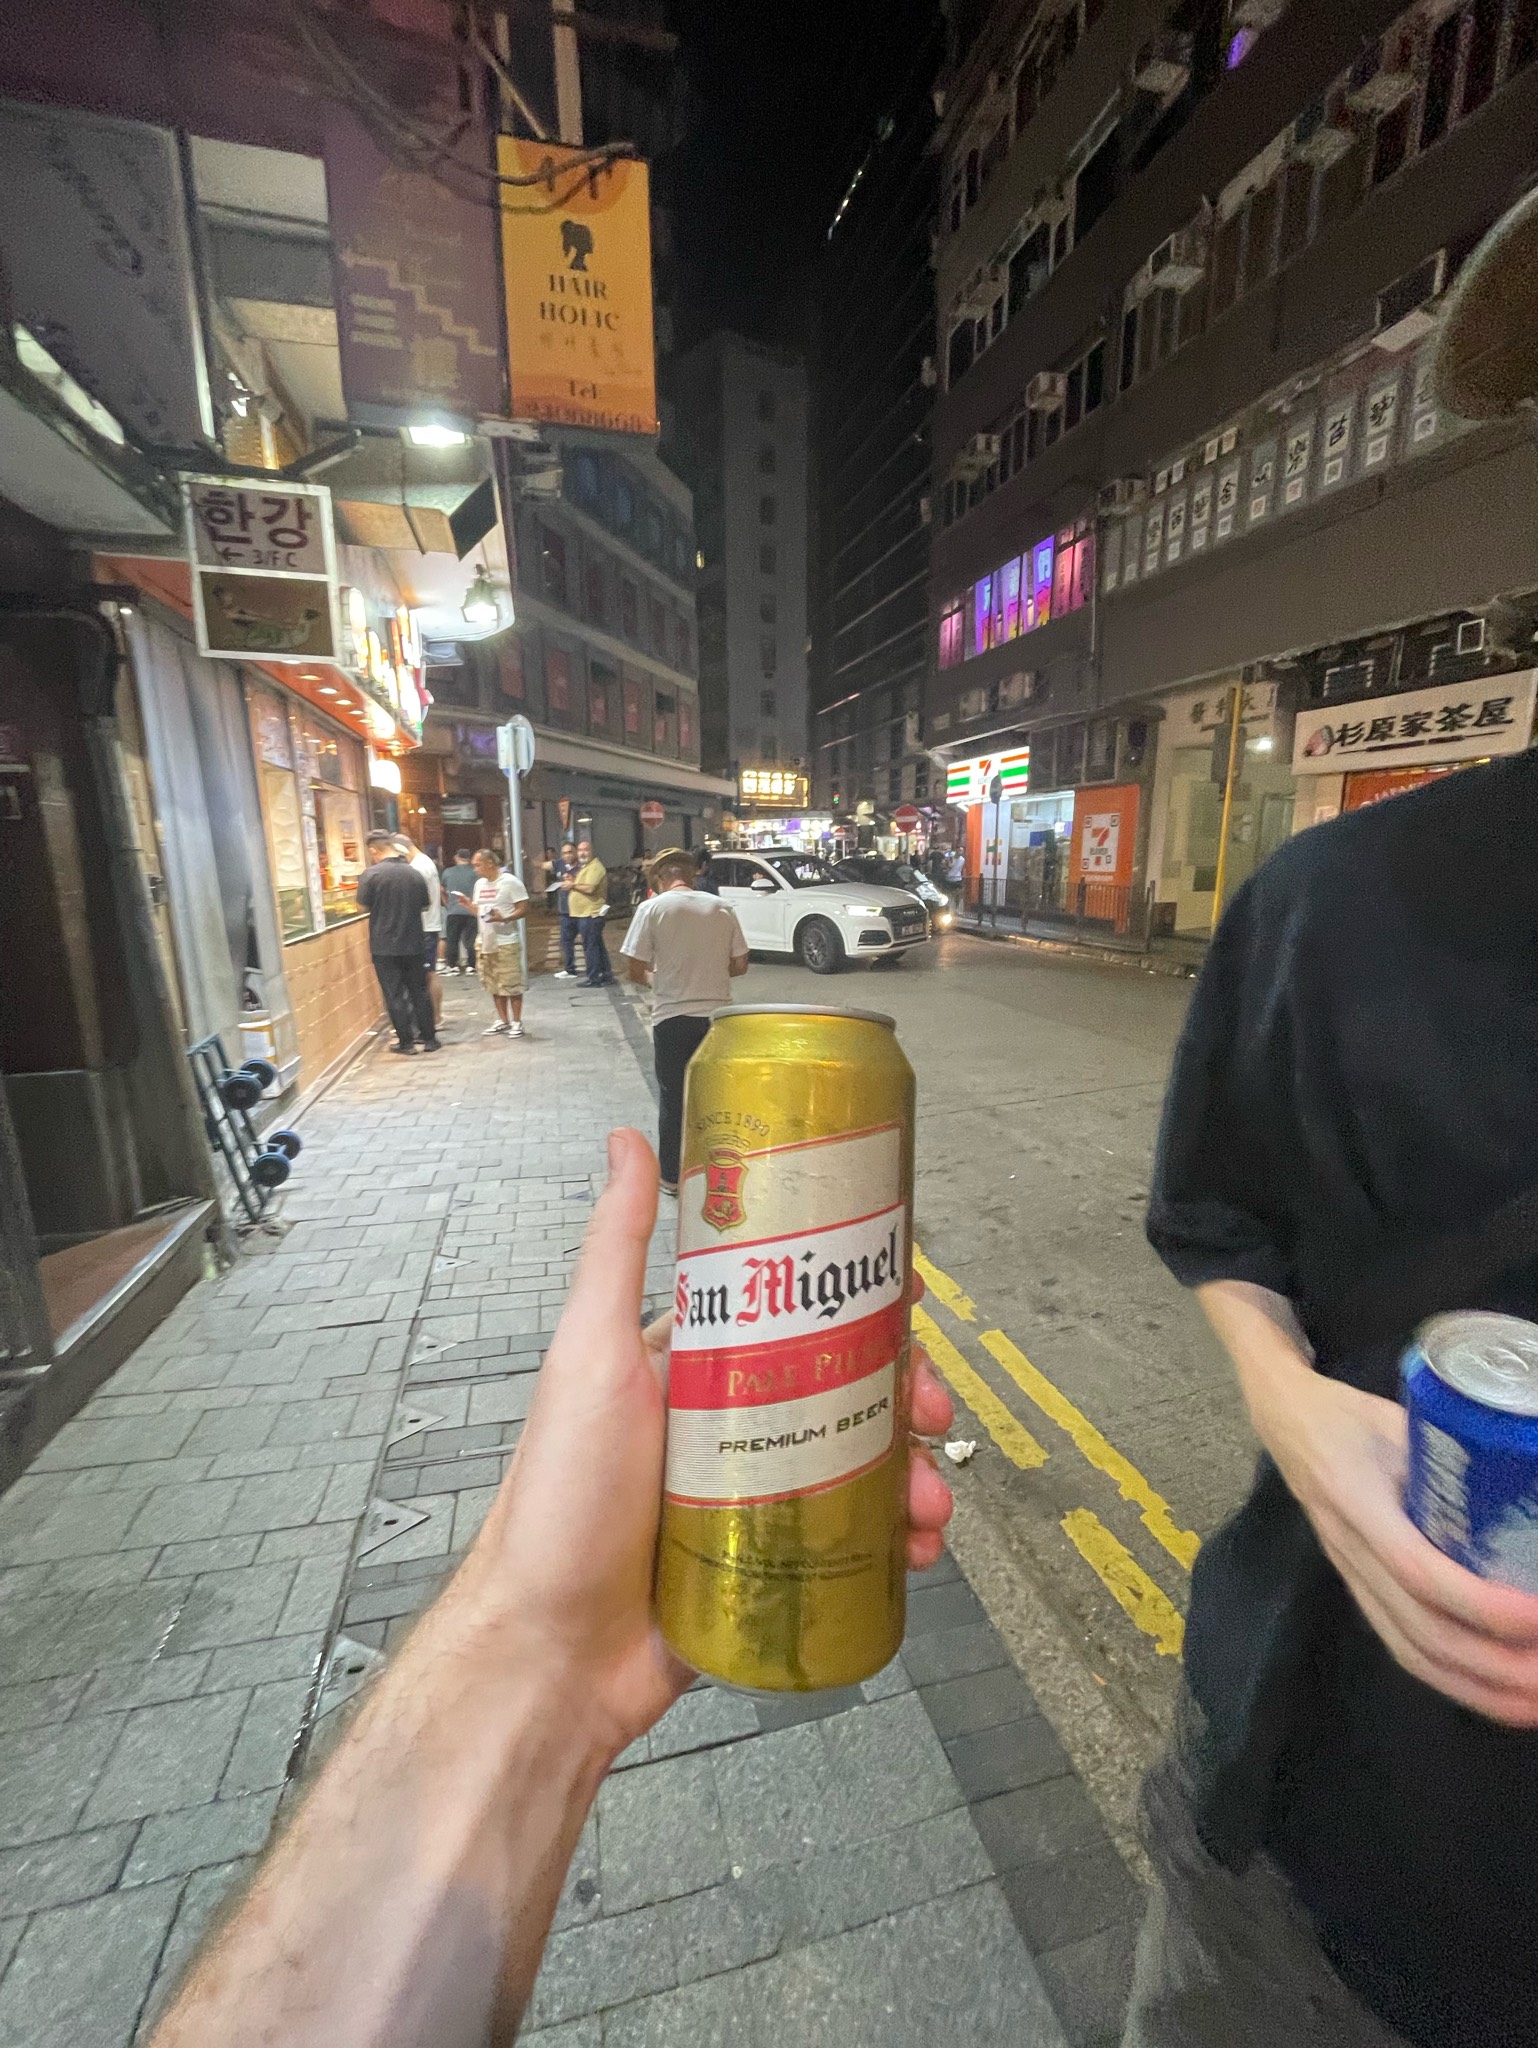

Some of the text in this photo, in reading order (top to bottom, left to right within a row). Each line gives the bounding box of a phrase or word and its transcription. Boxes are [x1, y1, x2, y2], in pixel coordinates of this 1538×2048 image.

[548, 274, 607, 299] HAIR
[539, 300, 619, 331] HOLIC
[201, 489, 312, 549] 한강
[1334, 696, 1515, 747] 杉原家茶屋
[735, 1112, 771, 1137] 1890
[675, 1222, 898, 1330] San Miguel
[718, 1395, 891, 1455] PREMIUM BEER
